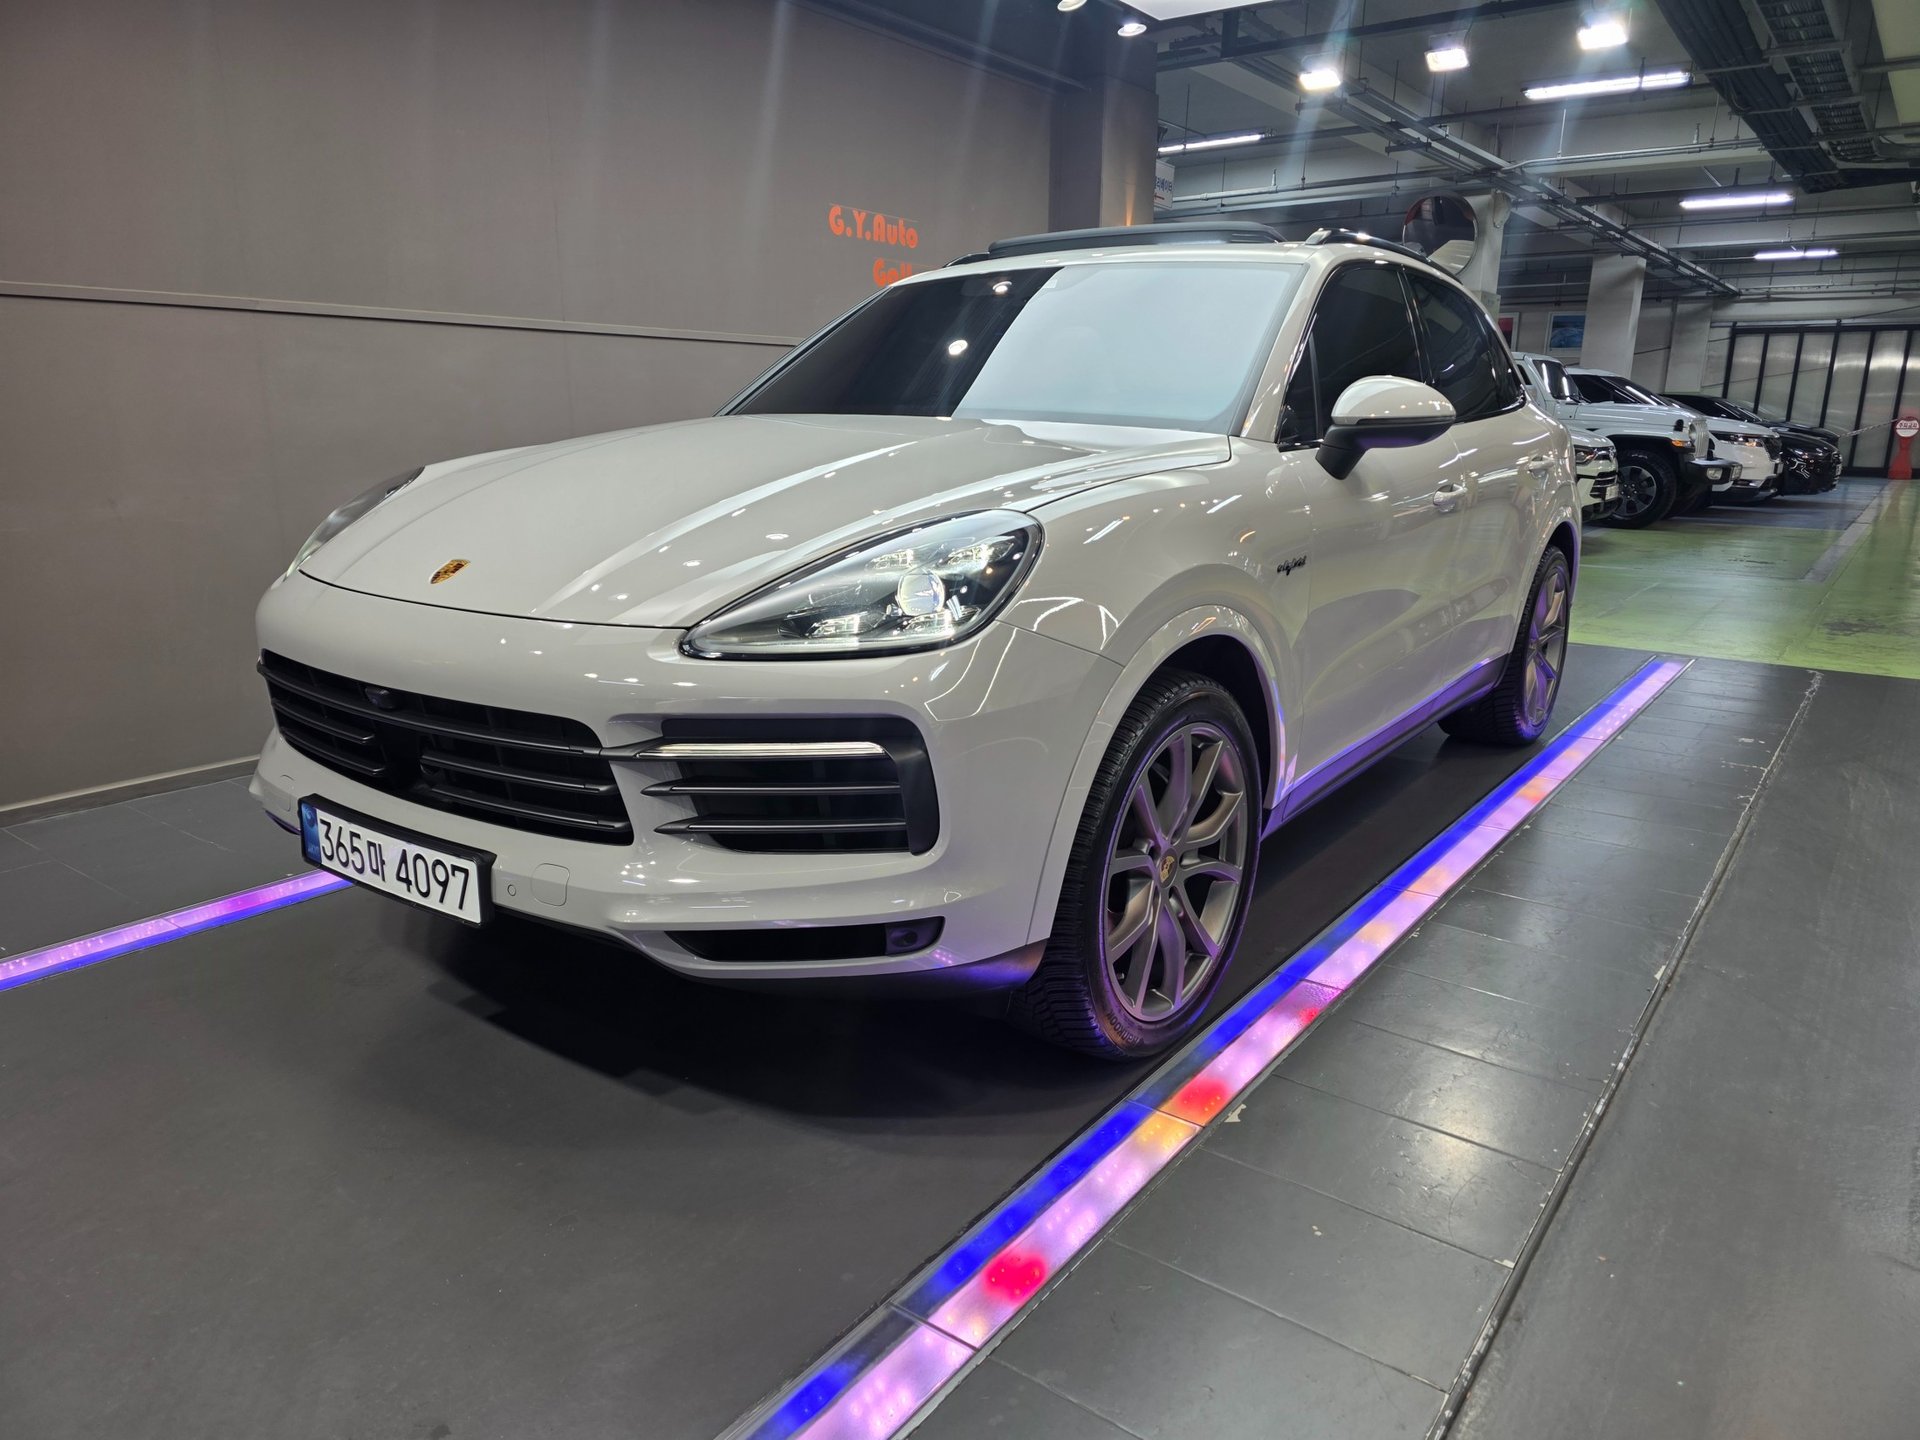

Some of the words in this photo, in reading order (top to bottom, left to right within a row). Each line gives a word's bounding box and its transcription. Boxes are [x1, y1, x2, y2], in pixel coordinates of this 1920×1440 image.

[828, 204, 919, 249] G.Y.Auto
[320, 818, 386, 881] 365마
[395, 848, 469, 910] 4097
